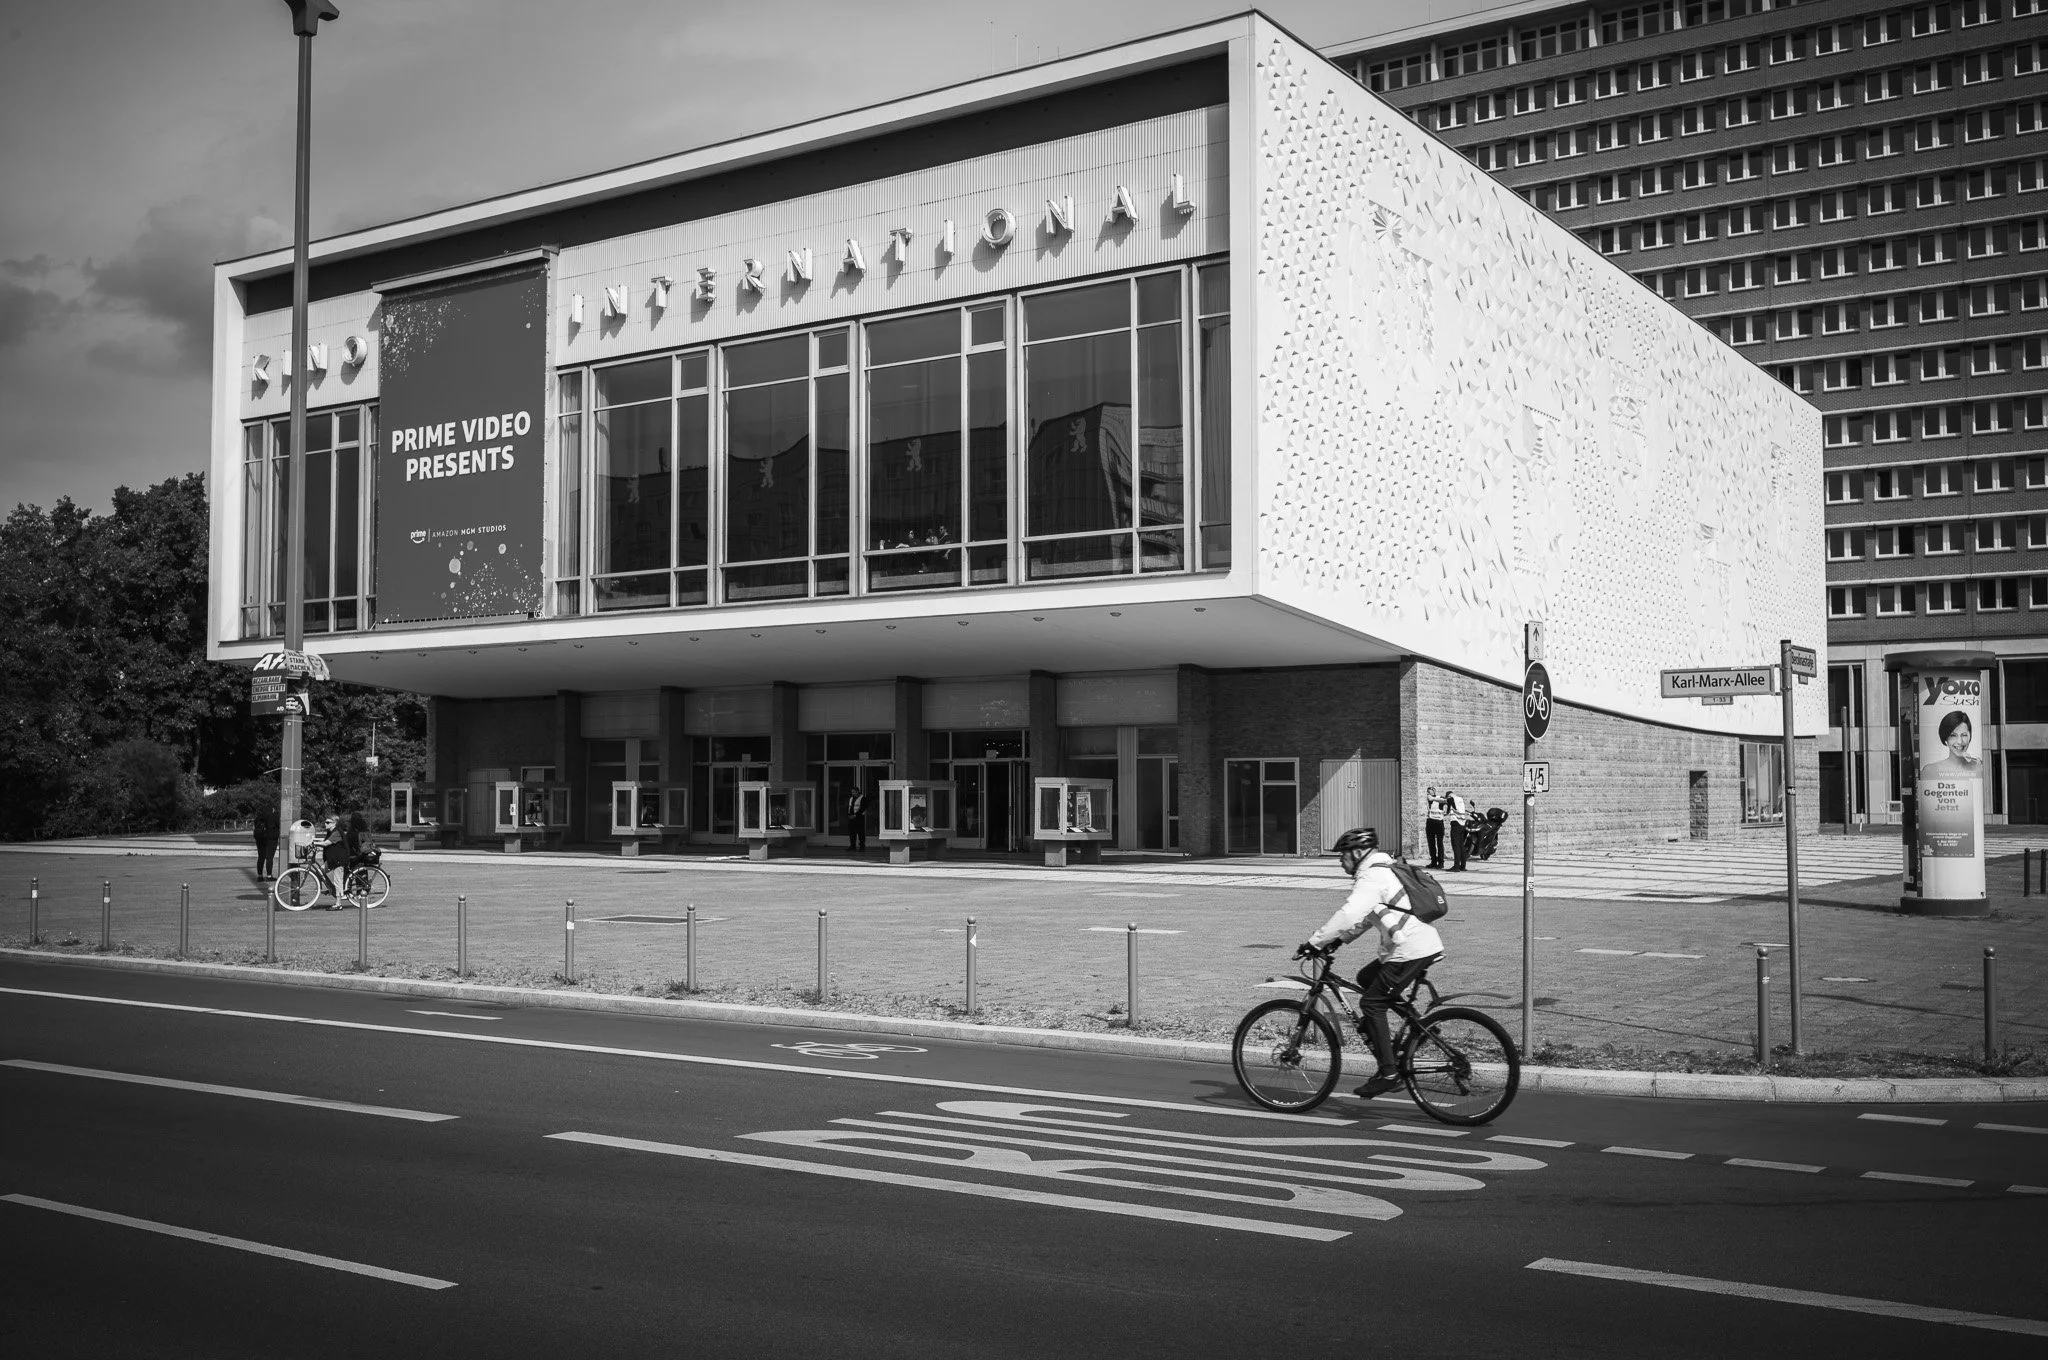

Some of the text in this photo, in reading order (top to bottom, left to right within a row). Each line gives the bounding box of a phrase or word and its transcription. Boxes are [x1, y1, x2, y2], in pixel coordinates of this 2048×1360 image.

[252, 172, 1197, 382] KINO INTERNATIONAL
[391, 410, 532, 453] PRIME VIDEO
[405, 444, 515, 482] PRESENTS
[410, 524, 507, 540] prime AMAZON MGM STUDIOS
[1671, 673, 1765, 689] Karl-Marx-Allee
[1528, 767, 1545, 787] 1/5
[1924, 789, 1969, 798] Gegenteil
